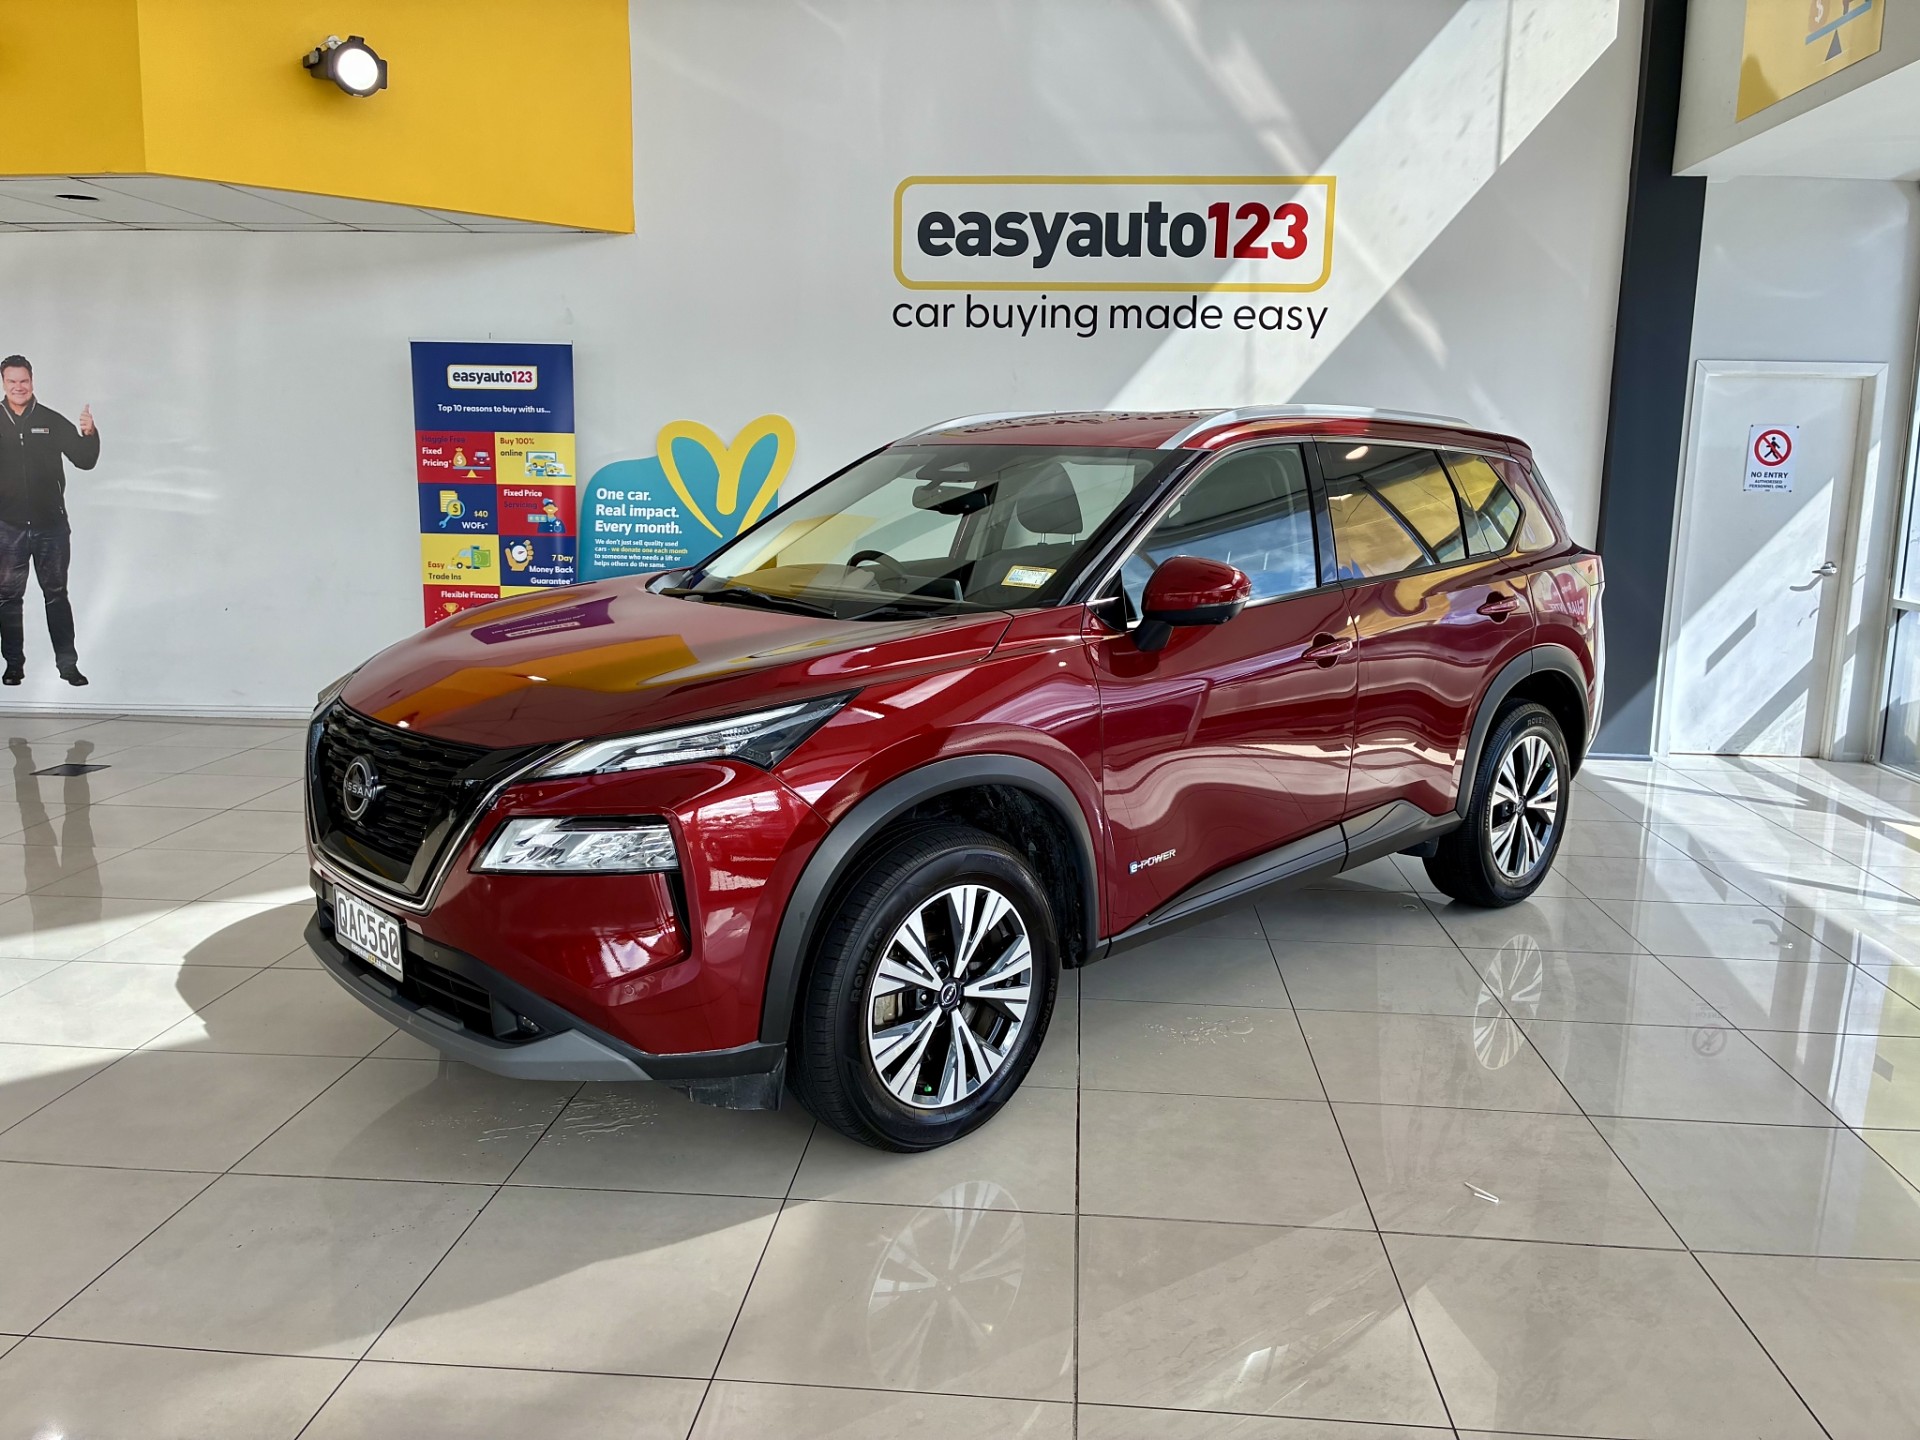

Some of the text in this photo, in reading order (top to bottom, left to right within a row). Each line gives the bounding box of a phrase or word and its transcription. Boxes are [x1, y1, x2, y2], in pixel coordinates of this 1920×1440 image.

[917, 201, 1309, 269] easyauto123
[892, 294, 1329, 339] car buying made easy
[452, 371, 533, 384] easyauto123
[438, 404, 452, 413] Top
[453, 404, 462, 412] 10
[493, 405, 501, 413] to
[502, 405, 518, 414] buy
[518, 405, 535, 413] with
[421, 436, 448, 444] Haggle
[500, 437, 514, 446] Buy
[422, 447, 442, 455] Fixed
[500, 449, 523, 457] online
[504, 489, 523, 497] Fixed
[596, 488, 651, 501] One car.
[504, 501, 537, 509] Servicing
[474, 510, 488, 518] $40
[595, 504, 679, 520] Real impact.
[595, 520, 682, 536] Every month.
[644, 540, 664, 548] quality
[558, 555, 573, 563] Day
[428, 561, 445, 570] Easy
[529, 566, 553, 574] Money
[470, 591, 498, 599] Finance
[338, 897, 400, 966] QAC560
